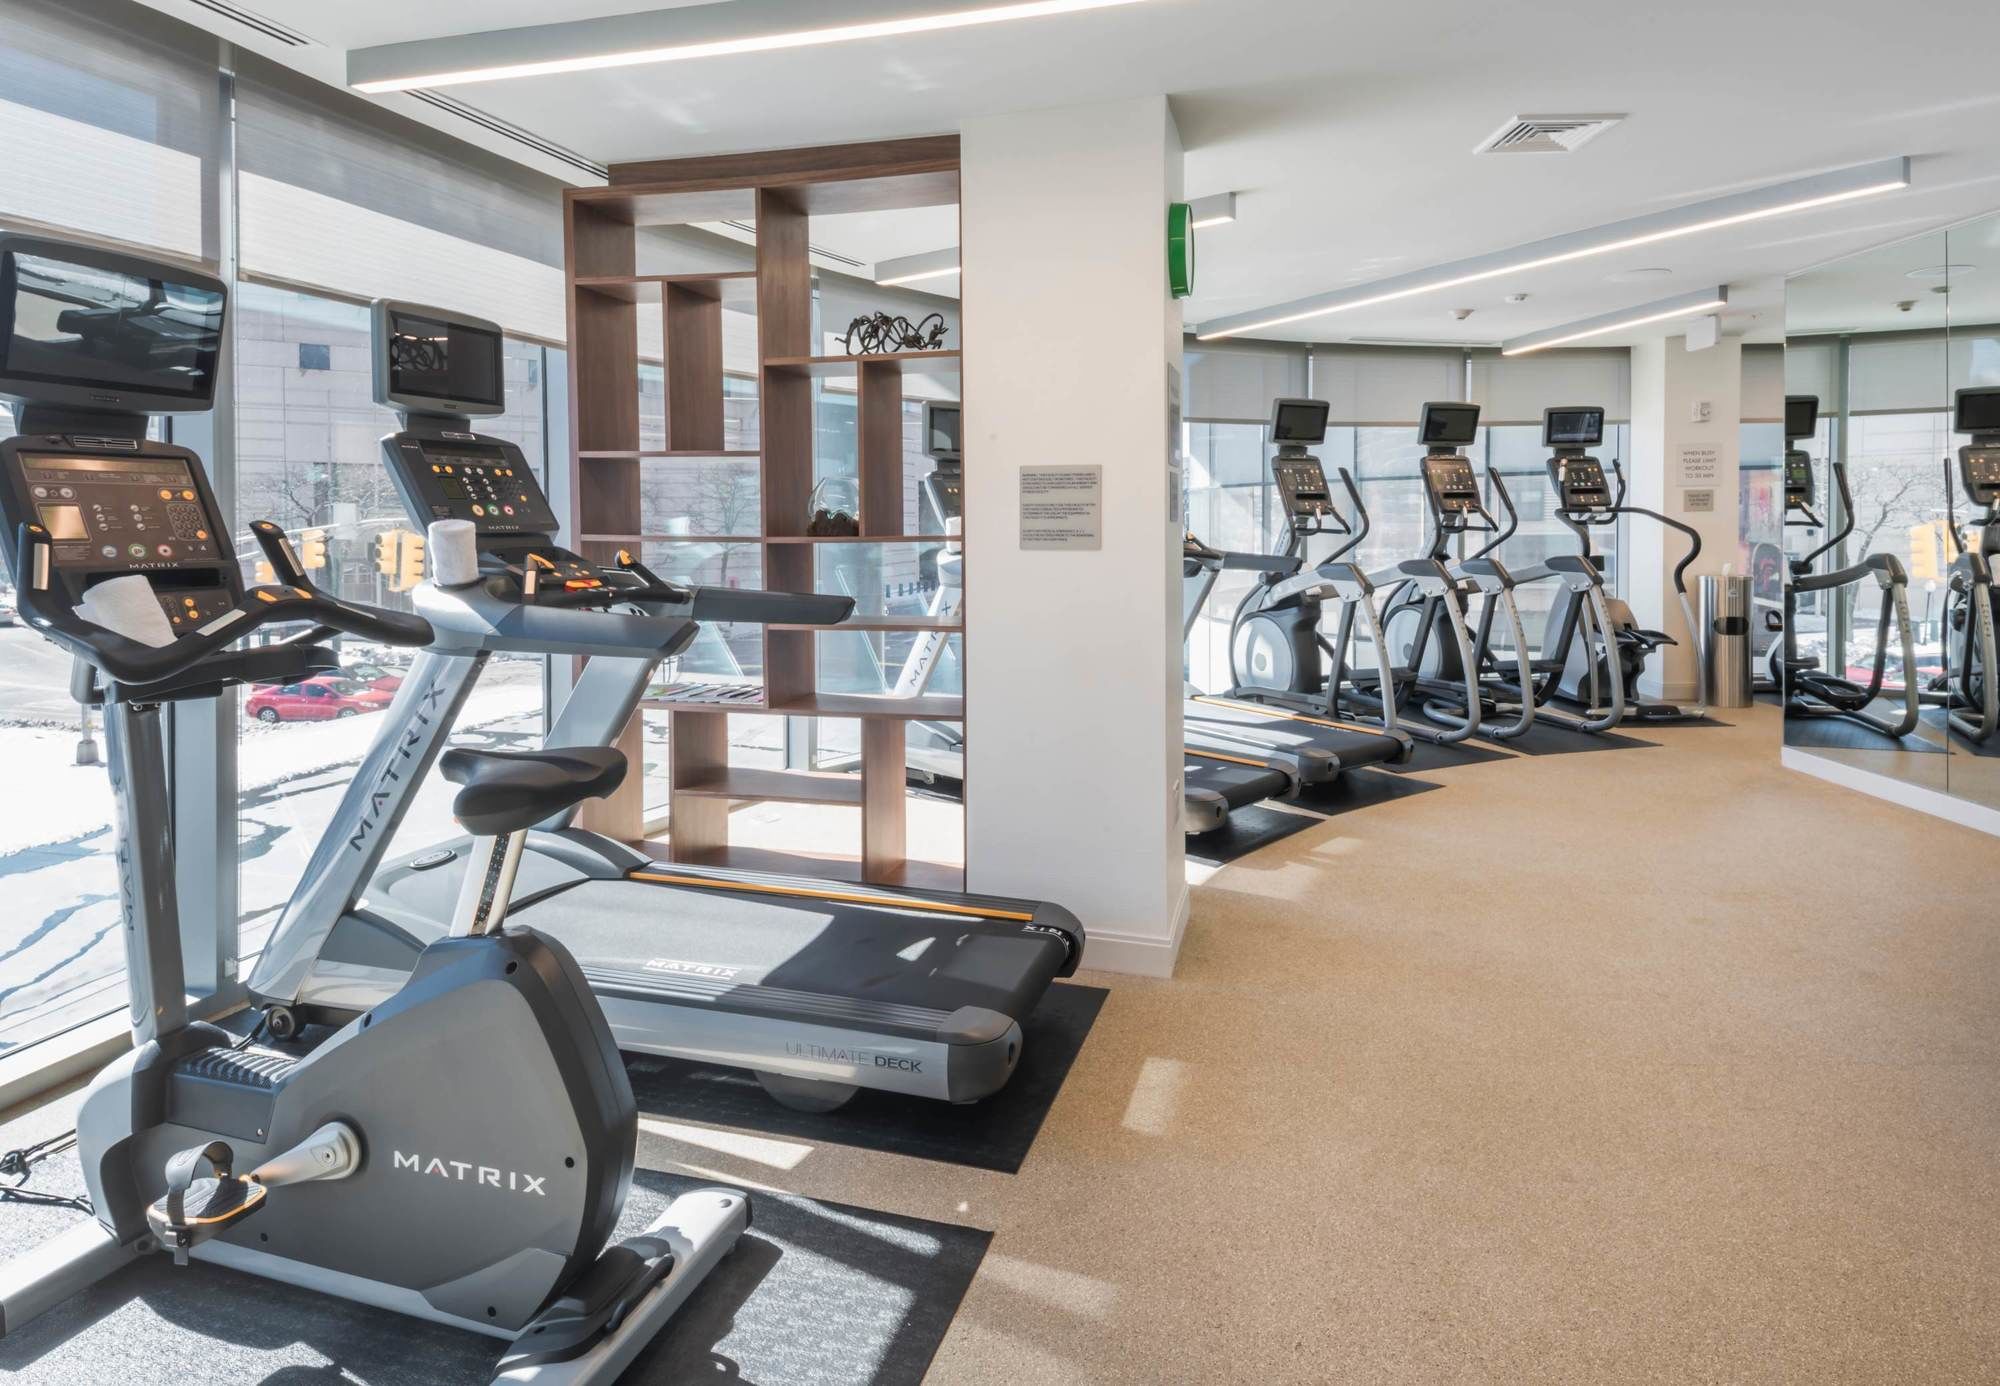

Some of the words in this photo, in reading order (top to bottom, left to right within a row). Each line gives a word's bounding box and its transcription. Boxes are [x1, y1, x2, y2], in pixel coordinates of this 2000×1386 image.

[350, 679, 445, 852] MATRIX
[646, 958, 738, 977] MATRIX
[785, 1040, 867, 1065] ULTIMATE
[874, 1056, 922, 1073] DECK
[393, 1150, 546, 1196] MATRIX
